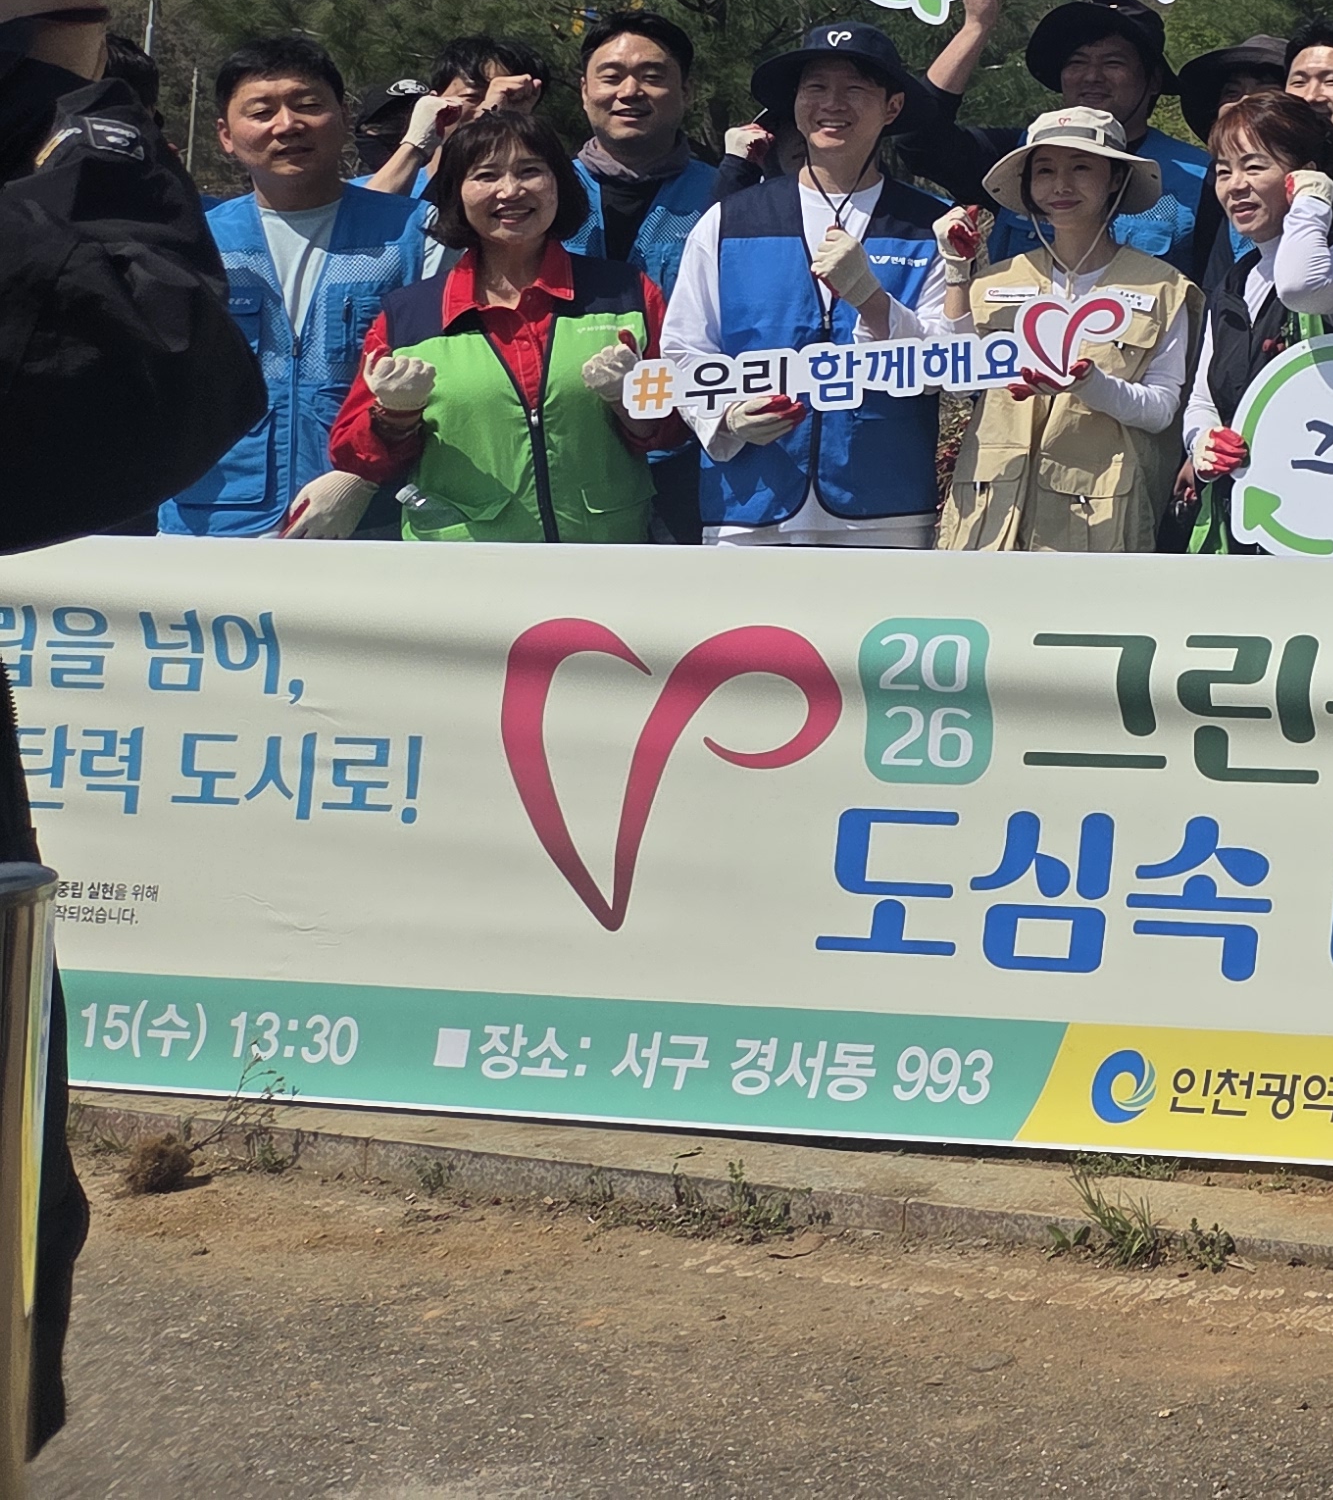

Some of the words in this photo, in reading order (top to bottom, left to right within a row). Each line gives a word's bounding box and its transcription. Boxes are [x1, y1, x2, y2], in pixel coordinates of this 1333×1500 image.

[808, 338, 1022, 402] 함께해요
[138, 609, 305, 705] 넘어,
[879, 632, 967, 694] 20
[879, 706, 974, 768] 26
[171, 731, 423, 825] 도시로!
[87, 881, 128, 901] 실현을
[131, 884, 160, 902] 위해
[815, 806, 1273, 983] 도심속
[81, 999, 207, 1062] 15(수)
[230, 1011, 360, 1066] 13:30
[611, 1031, 710, 1091] 서구
[731, 1037, 877, 1102] 경서동
[892, 1045, 994, 1105] 993
